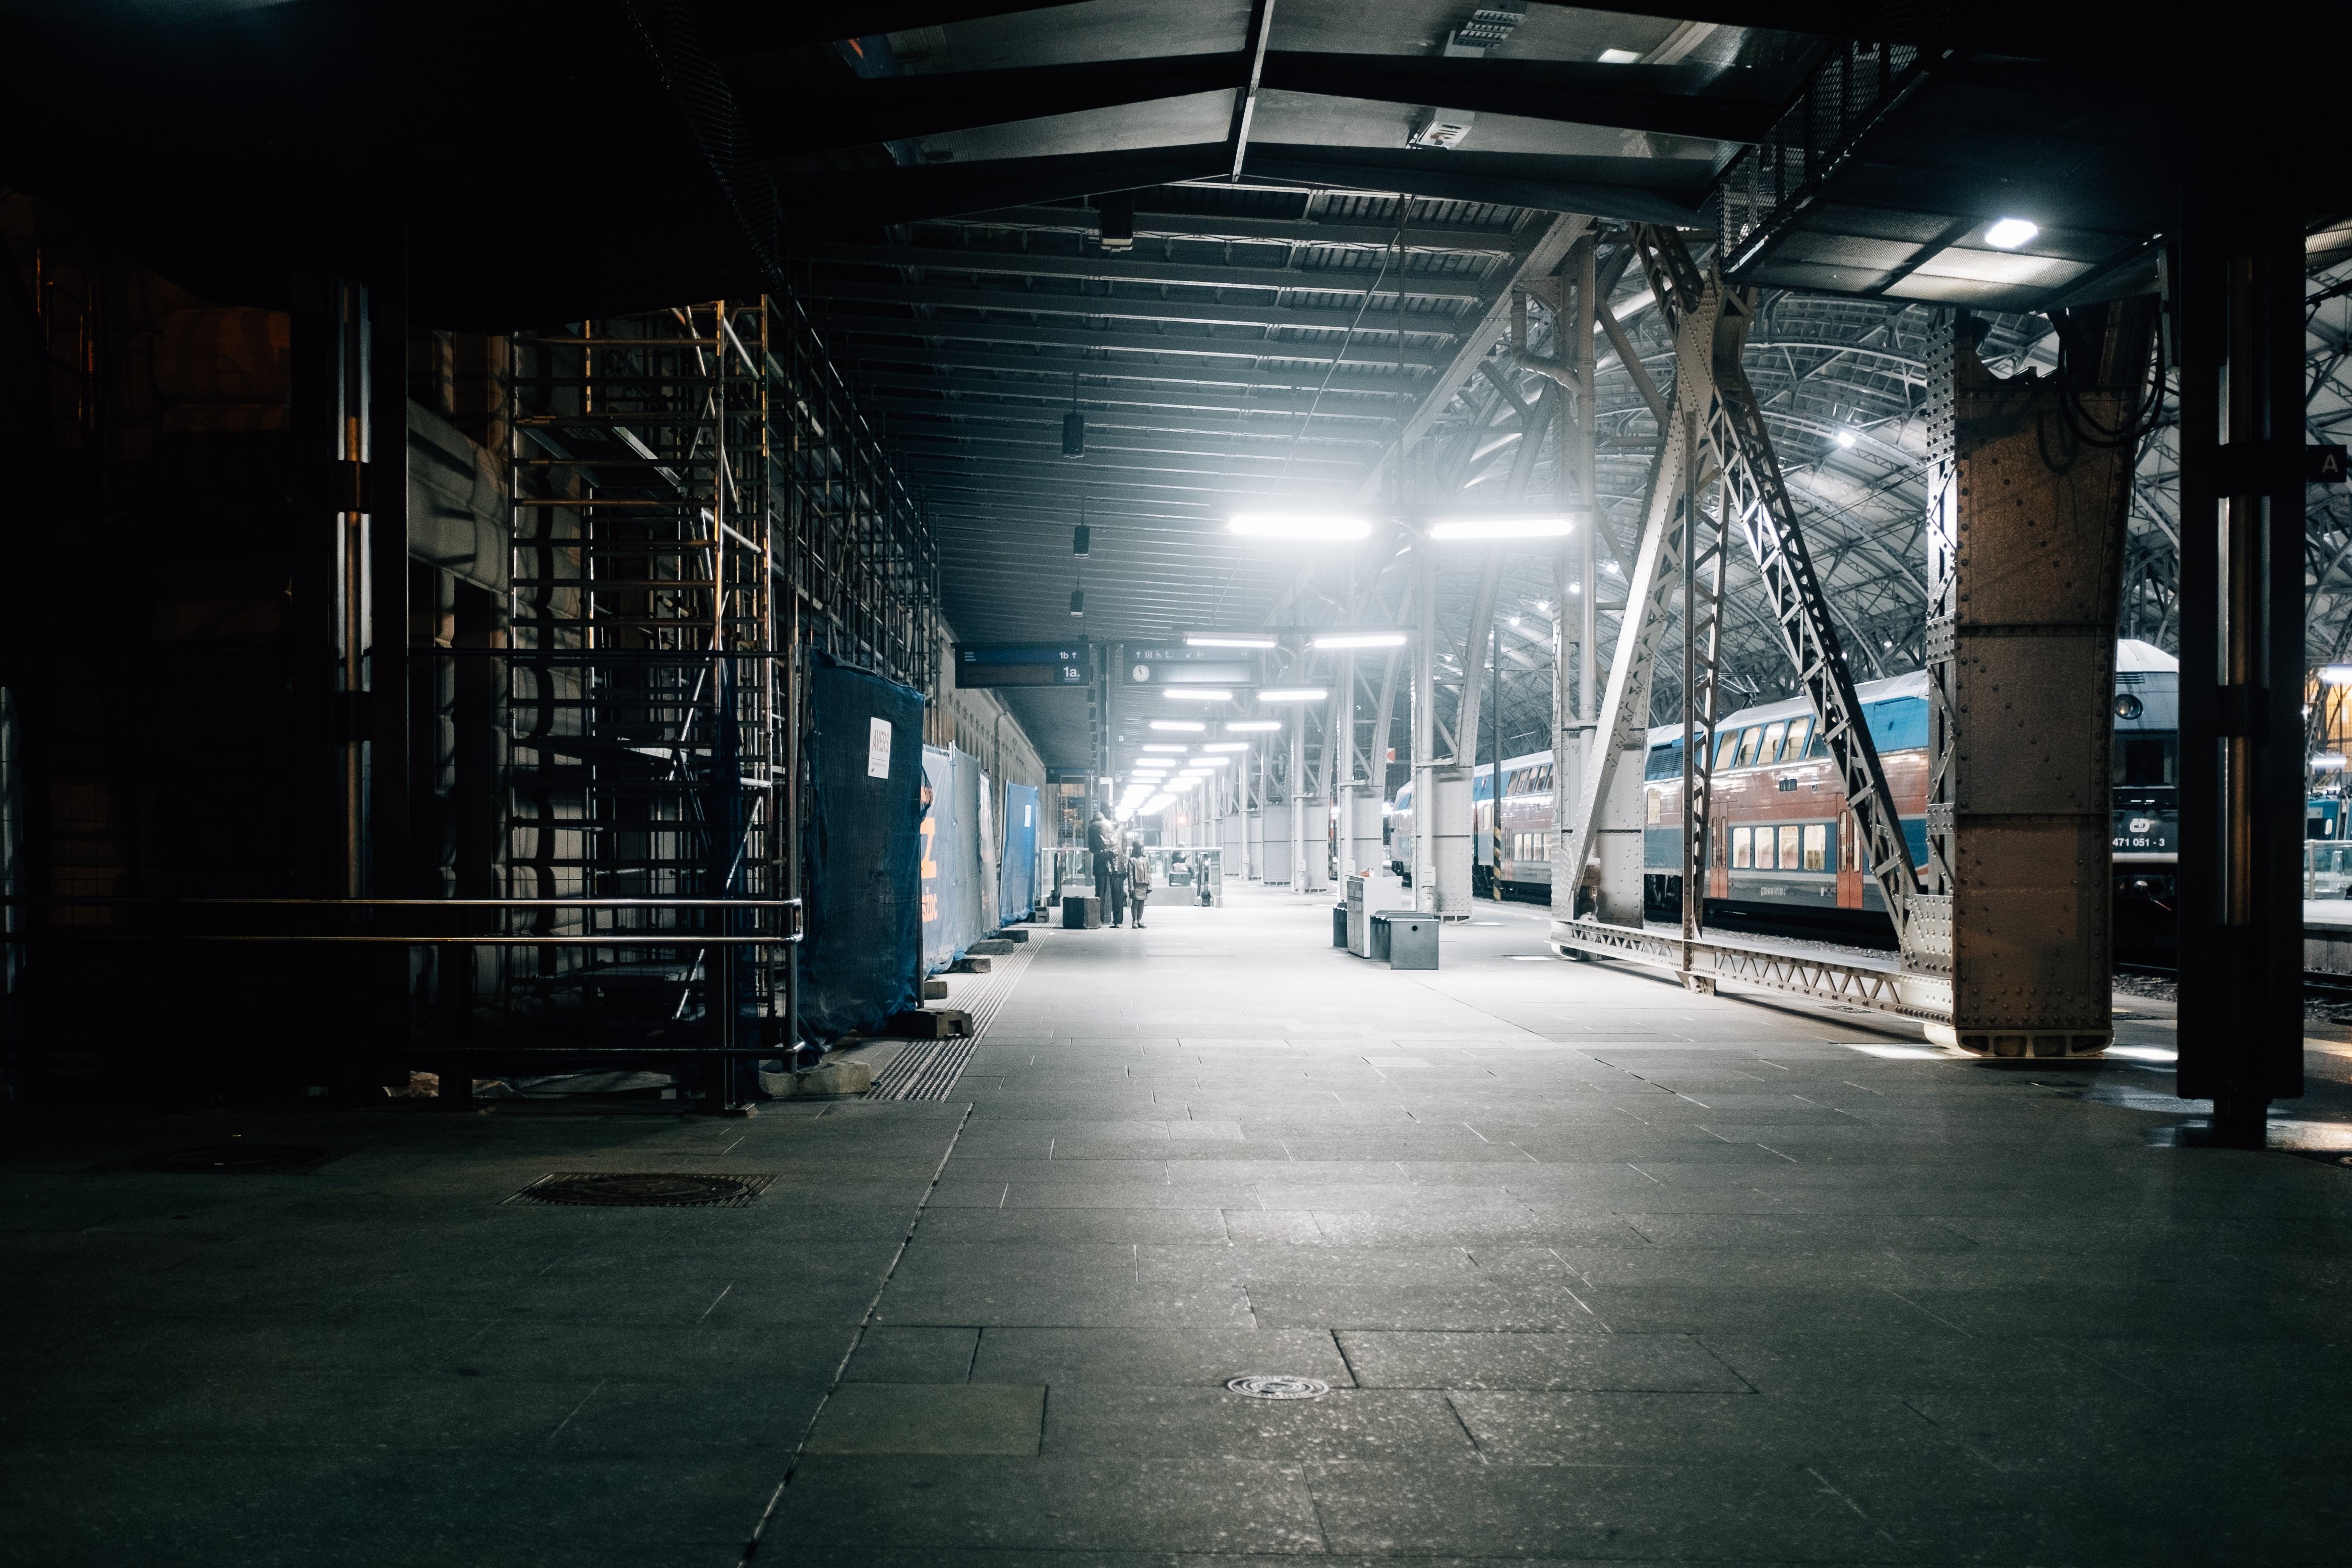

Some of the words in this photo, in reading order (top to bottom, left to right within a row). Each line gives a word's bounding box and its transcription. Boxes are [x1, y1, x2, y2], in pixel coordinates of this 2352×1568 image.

[2322, 454, 2339, 473] A
[872, 729, 889, 754] AVERS
[2113, 838, 2129, 847] 471
[2133, 838, 2149, 847] 051
[2159, 838, 2165, 847] 3
